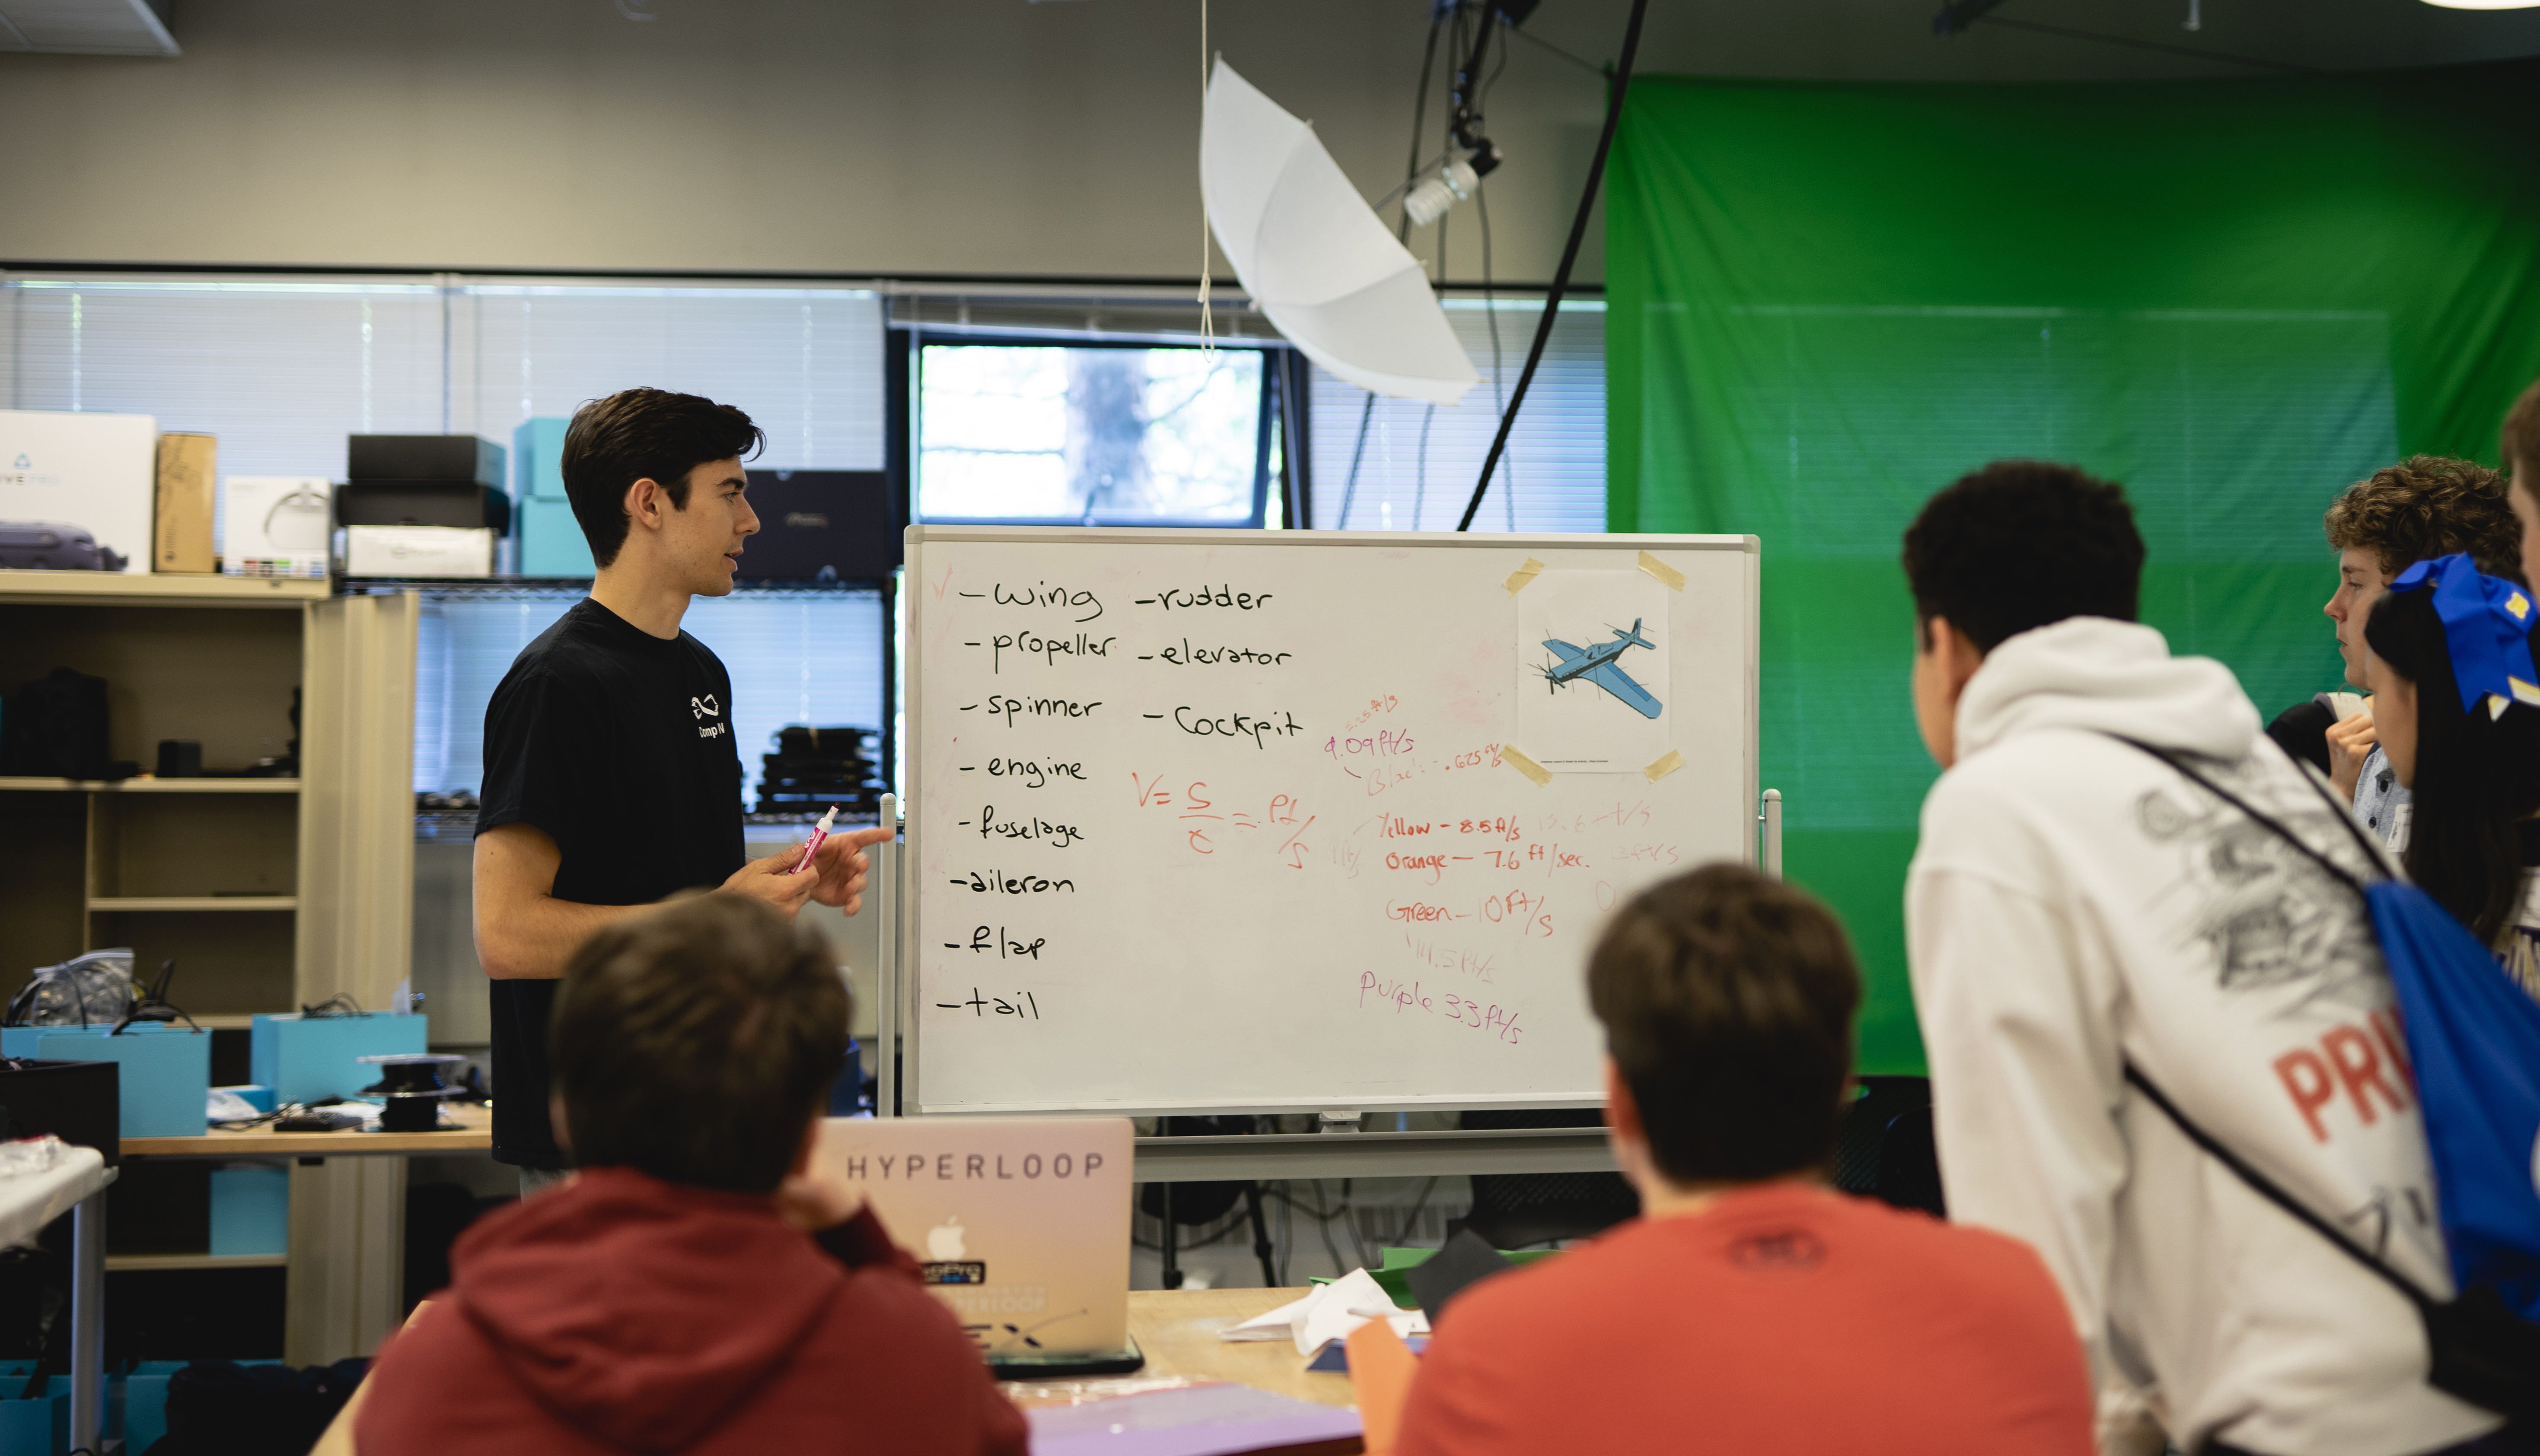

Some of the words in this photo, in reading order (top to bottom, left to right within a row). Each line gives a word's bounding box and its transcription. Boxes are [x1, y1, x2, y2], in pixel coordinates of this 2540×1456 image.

[993, 630, 1117, 675] propeller
[988, 695, 1103, 728] spinner
[698, 726, 718, 738] Comp
[987, 756, 1088, 789] engine
[1385, 851, 1448, 886] Orange
[1386, 899, 1453, 924] Green
[847, 1152, 1104, 1180] HYPERLOOP
